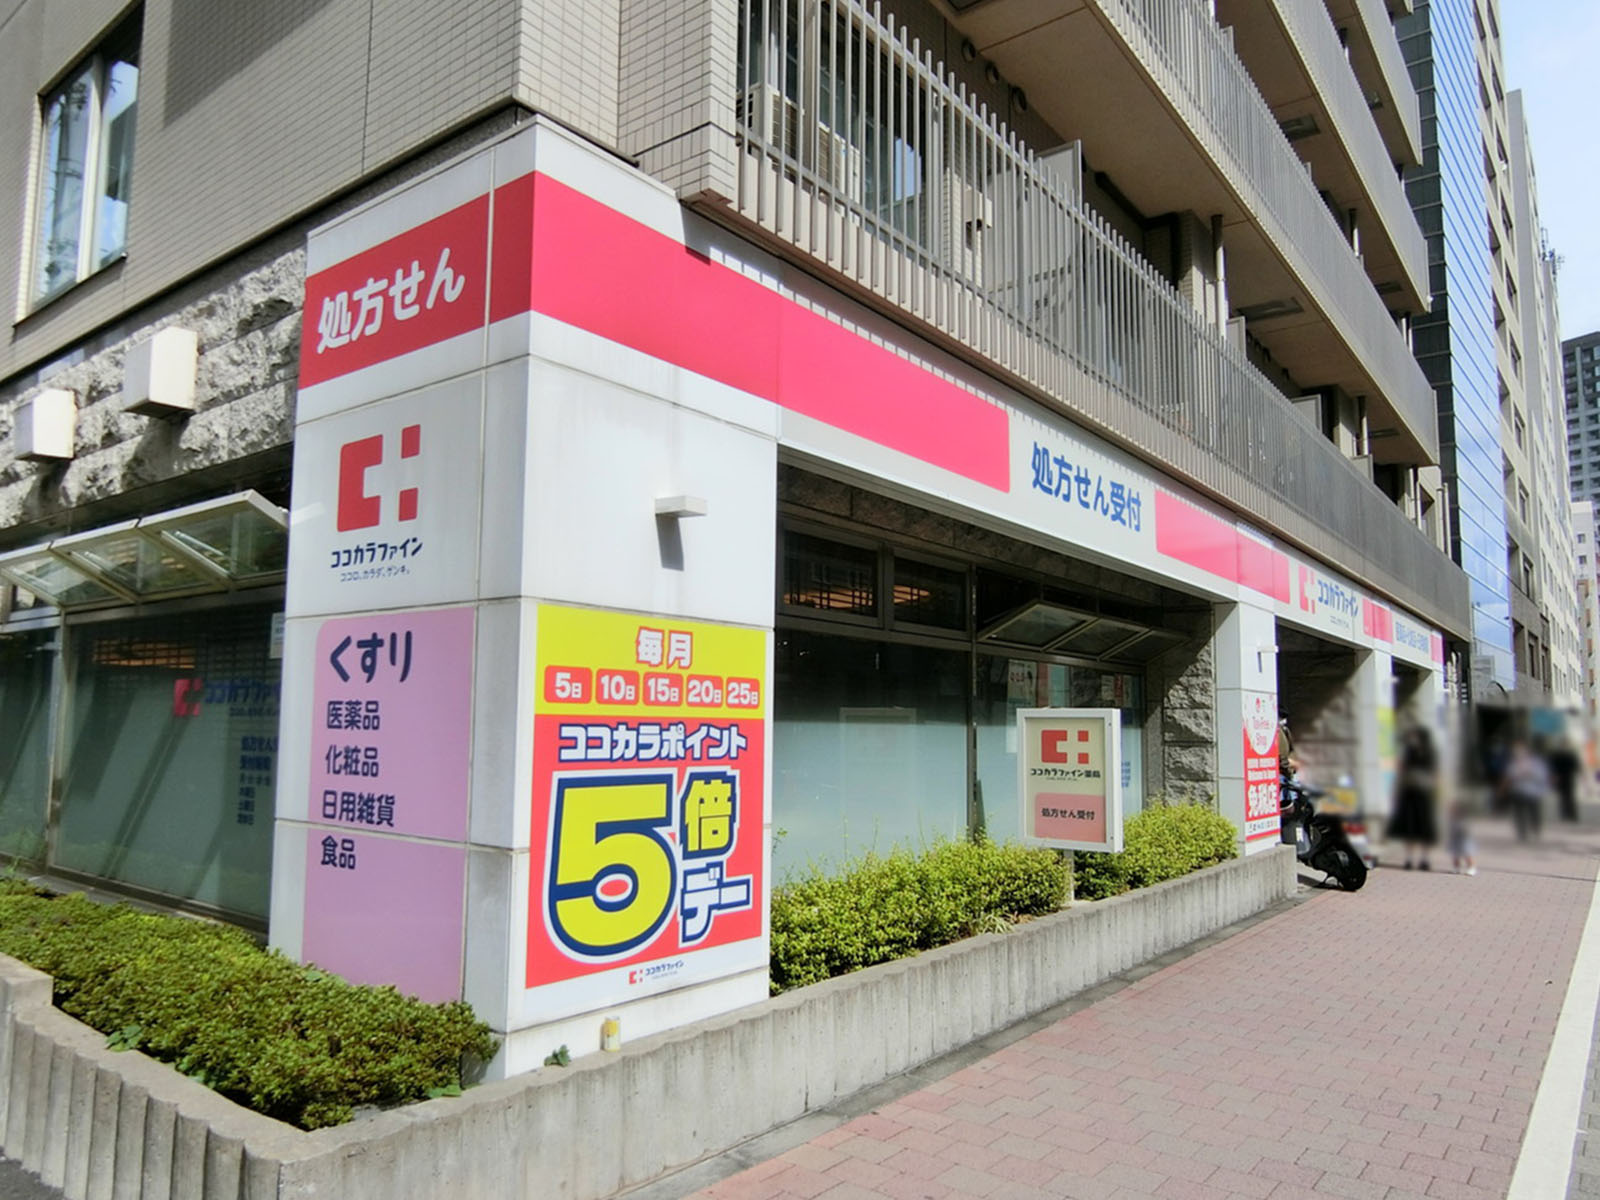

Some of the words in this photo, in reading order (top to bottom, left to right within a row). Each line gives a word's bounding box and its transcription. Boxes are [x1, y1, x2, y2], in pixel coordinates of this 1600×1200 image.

[317, 247, 465, 354] 処方せん
[1032, 441, 1142, 532] 処方せん受付
[331, 537, 423, 568] ココカラファイン
[330, 630, 412, 683] くすり
[636, 626, 693, 669] 毎月
[555, 672, 582, 699] 5日
[601, 675, 635, 700] 10日
[648, 677, 679, 702] 15日
[688, 680, 722, 704] 20日
[727, 682, 759, 705] 25日
[326, 700, 380, 730] 医薬品
[558, 721, 747, 762] ココカラポイント
[325, 745, 379, 777] 化粧品
[322, 790, 395, 827] 日用雑貨
[1041, 808, 1095, 820] 処方せん受付
[321, 835, 356, 869] 食品
